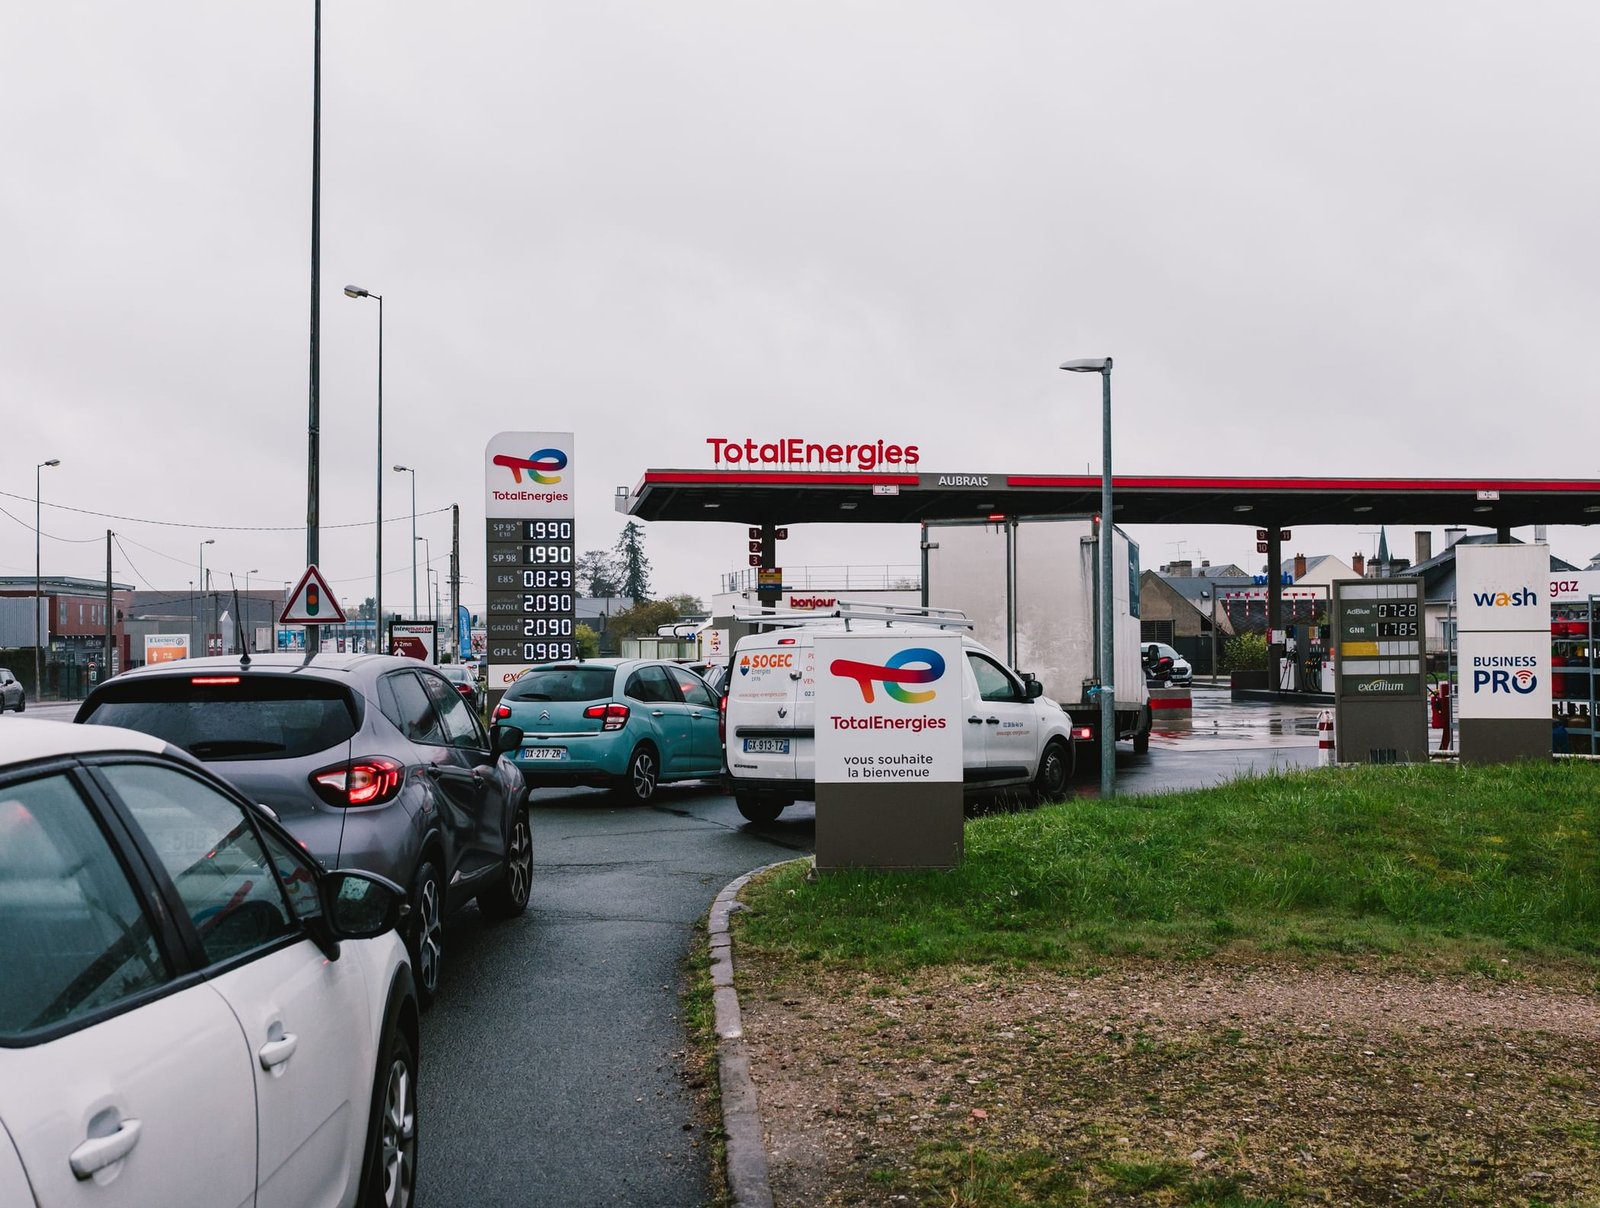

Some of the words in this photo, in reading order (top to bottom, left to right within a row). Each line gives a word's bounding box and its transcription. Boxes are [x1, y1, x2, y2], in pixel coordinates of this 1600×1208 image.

[706, 438, 920, 470] TotalEnergies
[938, 475, 989, 487] AUBRAIS
[492, 491, 569, 503] TotalEnergies
[530, 522, 571, 540] 1.990
[752, 529, 758, 538] 1
[779, 530, 785, 538] 4
[1259, 531, 1265, 540] 9
[1282, 531, 1290, 539] 11
[752, 543, 758, 552] 2
[492, 554, 504, 562] SP
[505, 554, 517, 562] 98
[530, 546, 571, 564] 1.990
[752, 556, 758, 565] 3
[497, 575, 514, 583] E85
[523, 570, 571, 588] 0.829
[1253, 571, 1294, 586] wh
[1550, 581, 1579, 597] gaz
[790, 596, 836, 609] bonjour
[1473, 586, 1537, 607] wash
[491, 603, 519, 611] GAZOLE
[523, 594, 572, 613] 2.090
[1346, 608, 1371, 616] AdBlue
[1378, 604, 1417, 618] 0728
[491, 624, 519, 632] GAZOLE
[523, 619, 572, 637] 2.090
[1384, 622, 1417, 636] 1785
[493, 648, 518, 656] GPLc
[524, 643, 572, 661] 0.989
[751, 654, 793, 668] SOGEC
[1473, 656, 1537, 667] BUSINESS
[1358, 680, 1404, 691] excellium
[1473, 669, 1538, 694] PRO
[830, 714, 947, 732] TotalEnergies
[747, 740, 784, 751] GX-913-TZ
[525, 748, 561, 759] DX-217-ZR
[844, 756, 874, 765] vous
[878, 754, 933, 765] souhaite
[848, 768, 859, 778] la
[863, 767, 930, 778] bienvenue
